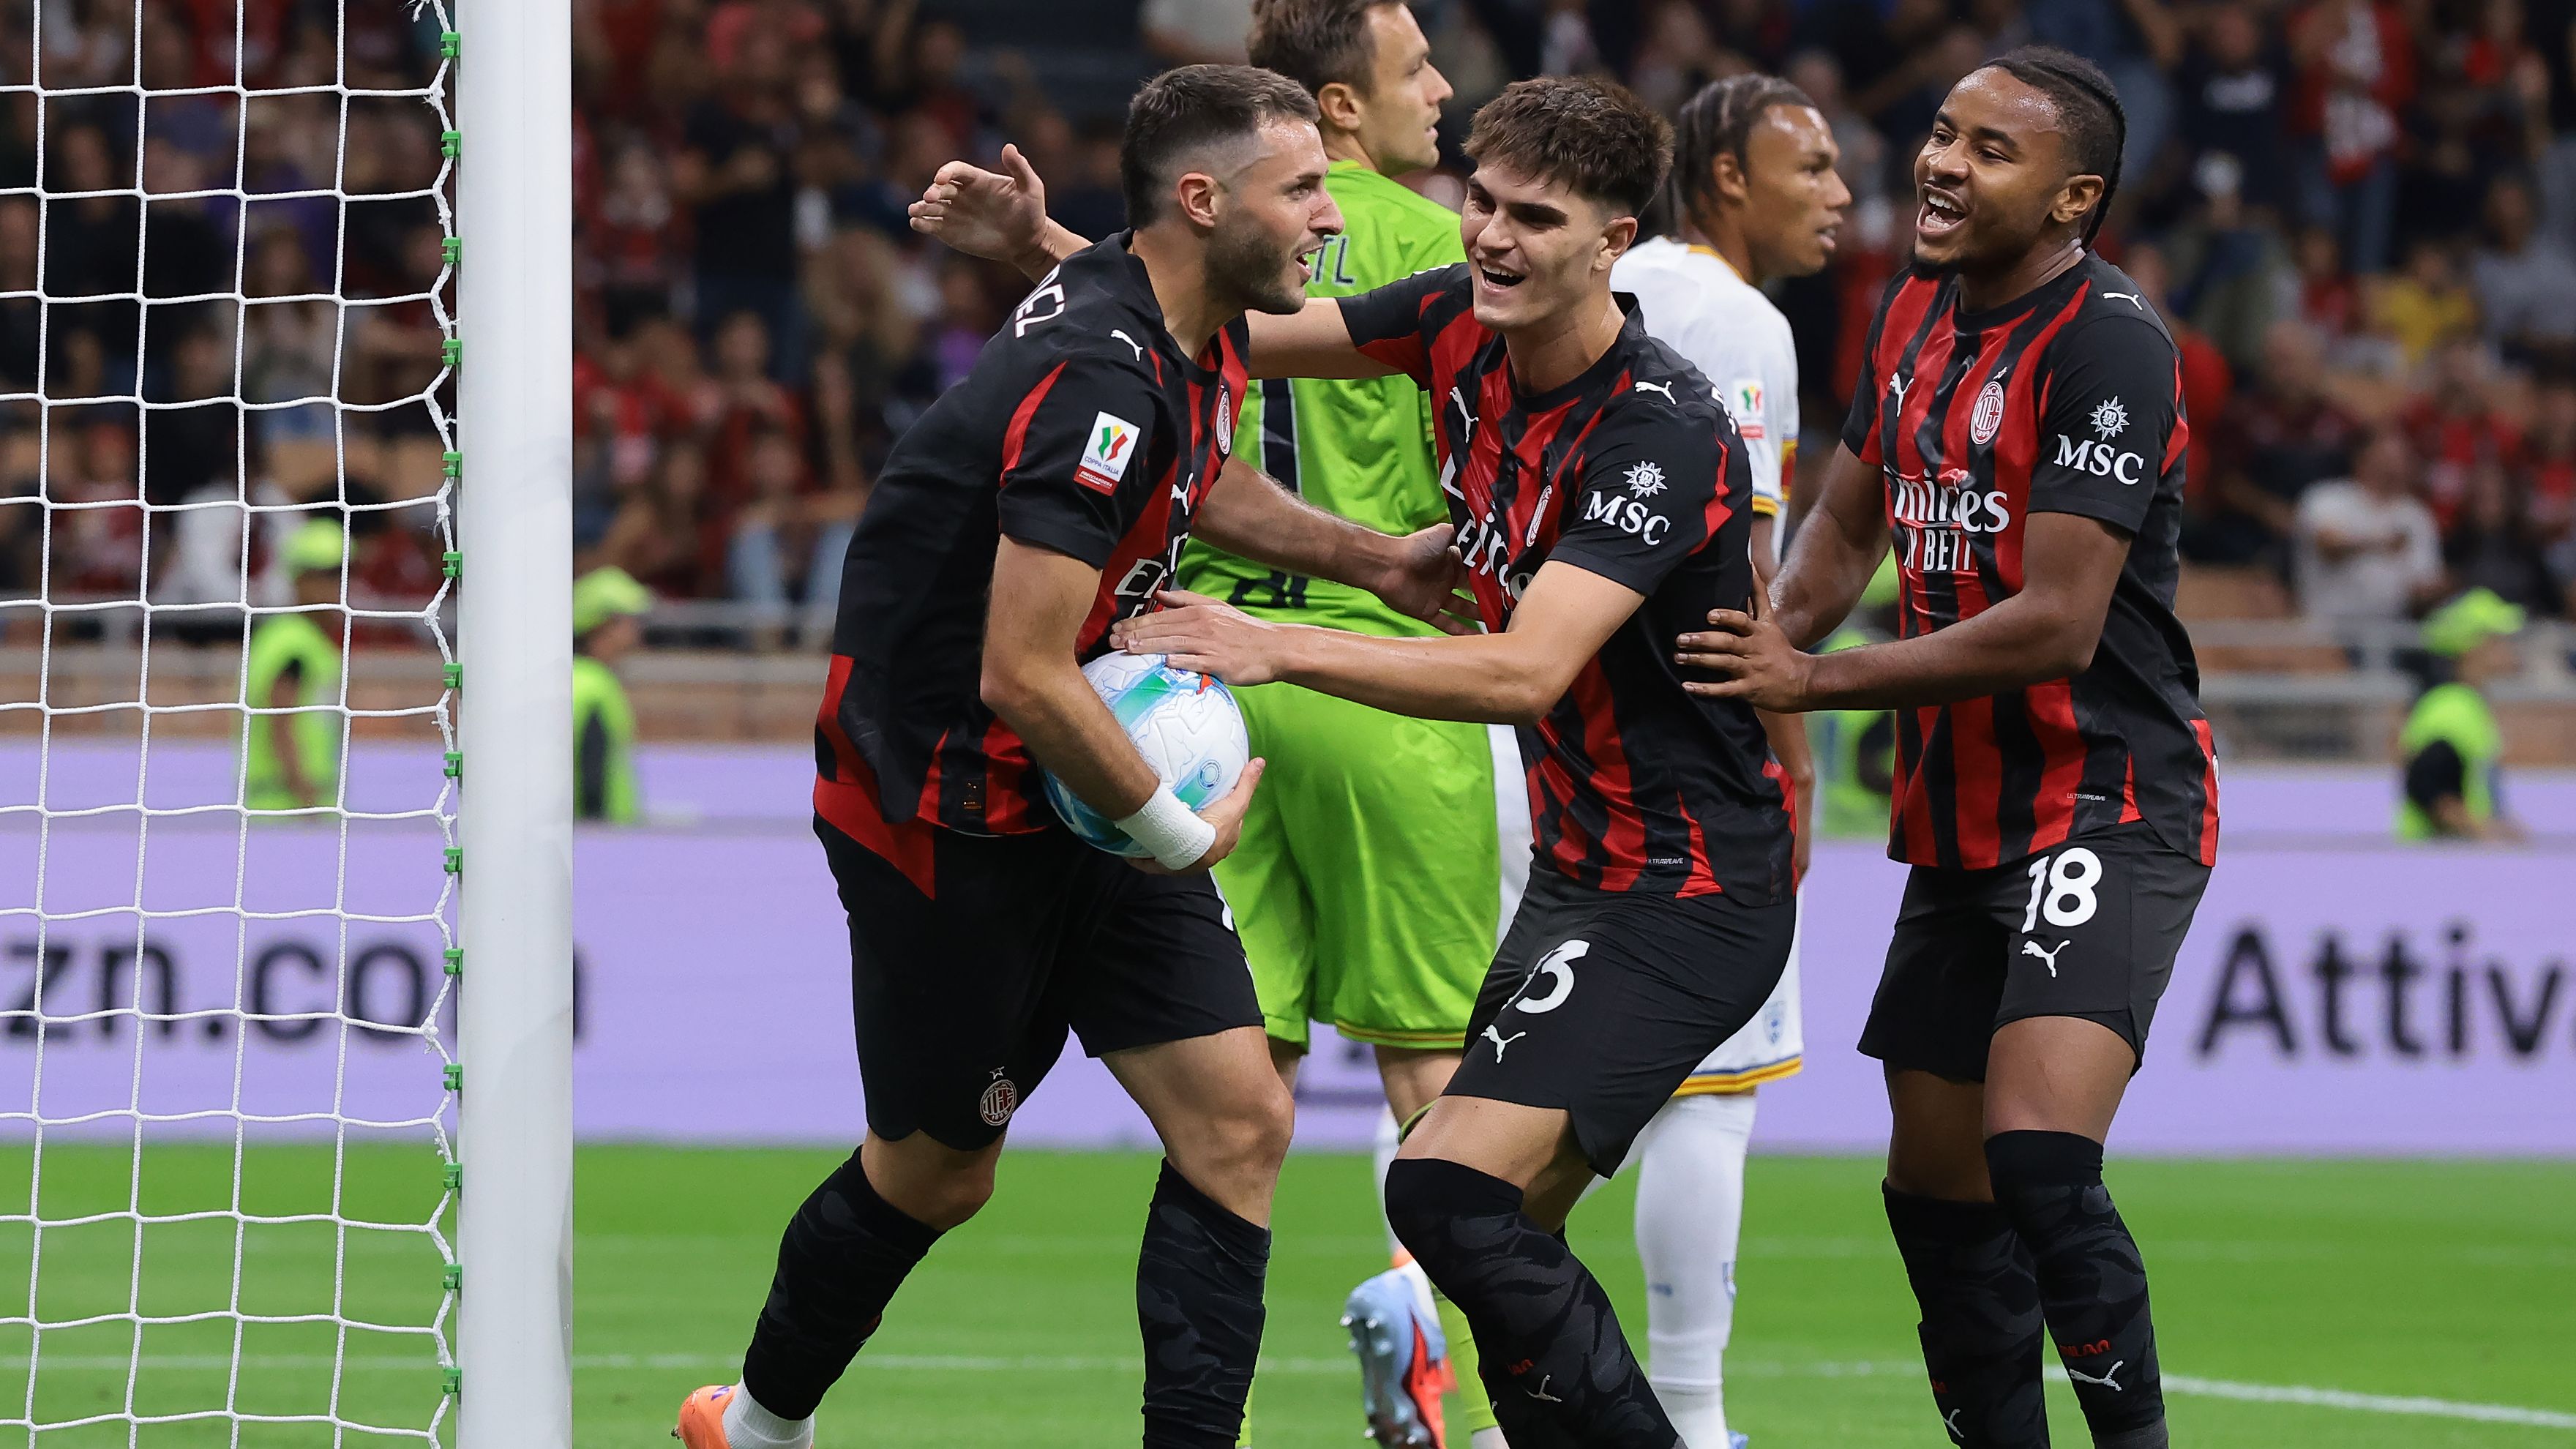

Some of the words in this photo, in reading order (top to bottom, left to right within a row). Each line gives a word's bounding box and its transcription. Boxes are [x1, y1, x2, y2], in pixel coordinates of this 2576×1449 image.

[2053, 433, 2144, 484] MSC
[1584, 490, 1671, 545] MSC
[2021, 847, 2103, 934] 18
[9, 941, 585, 1041] zn.co
[2198, 926, 2576, 1057] Attiv
